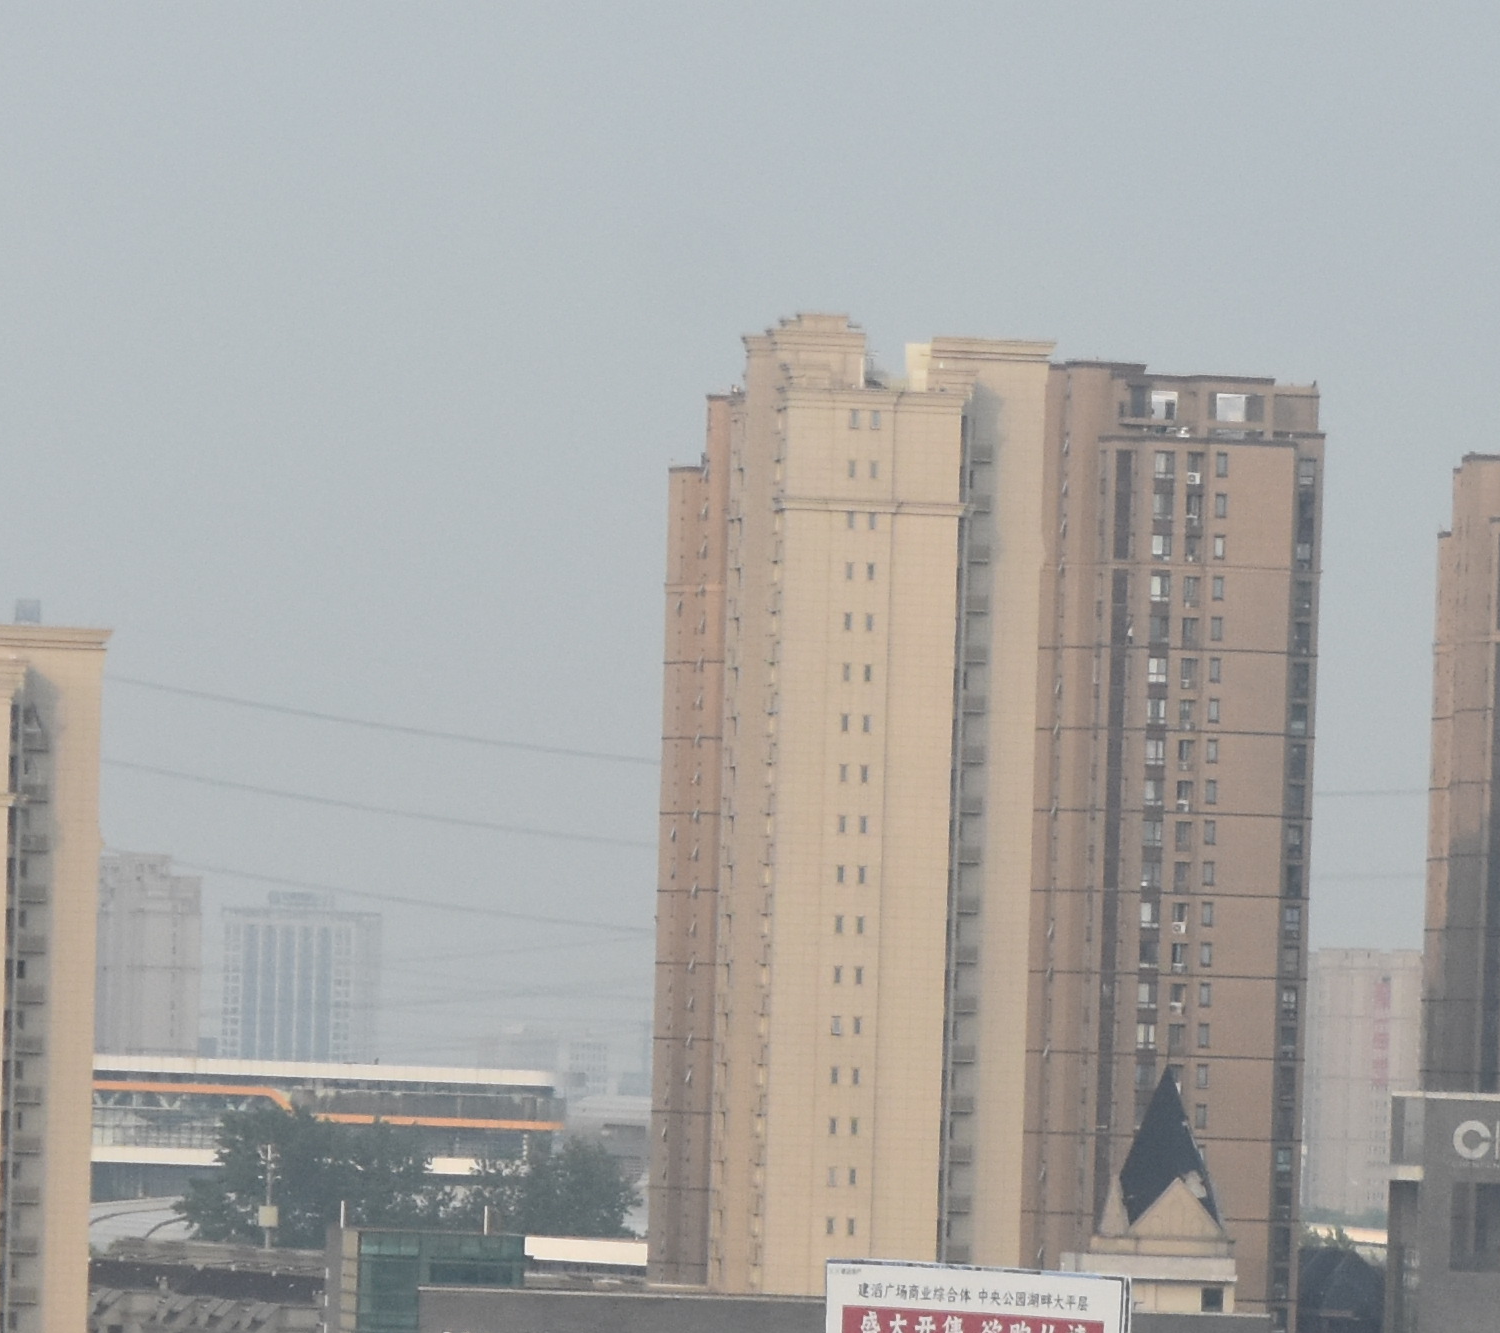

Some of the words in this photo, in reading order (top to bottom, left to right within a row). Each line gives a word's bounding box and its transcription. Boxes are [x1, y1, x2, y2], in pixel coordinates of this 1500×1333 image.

[858, 1282, 971, 1304] 建滔广场商业综合体
[978, 1288, 1088, 1311] 中央公园湖畔大平层
